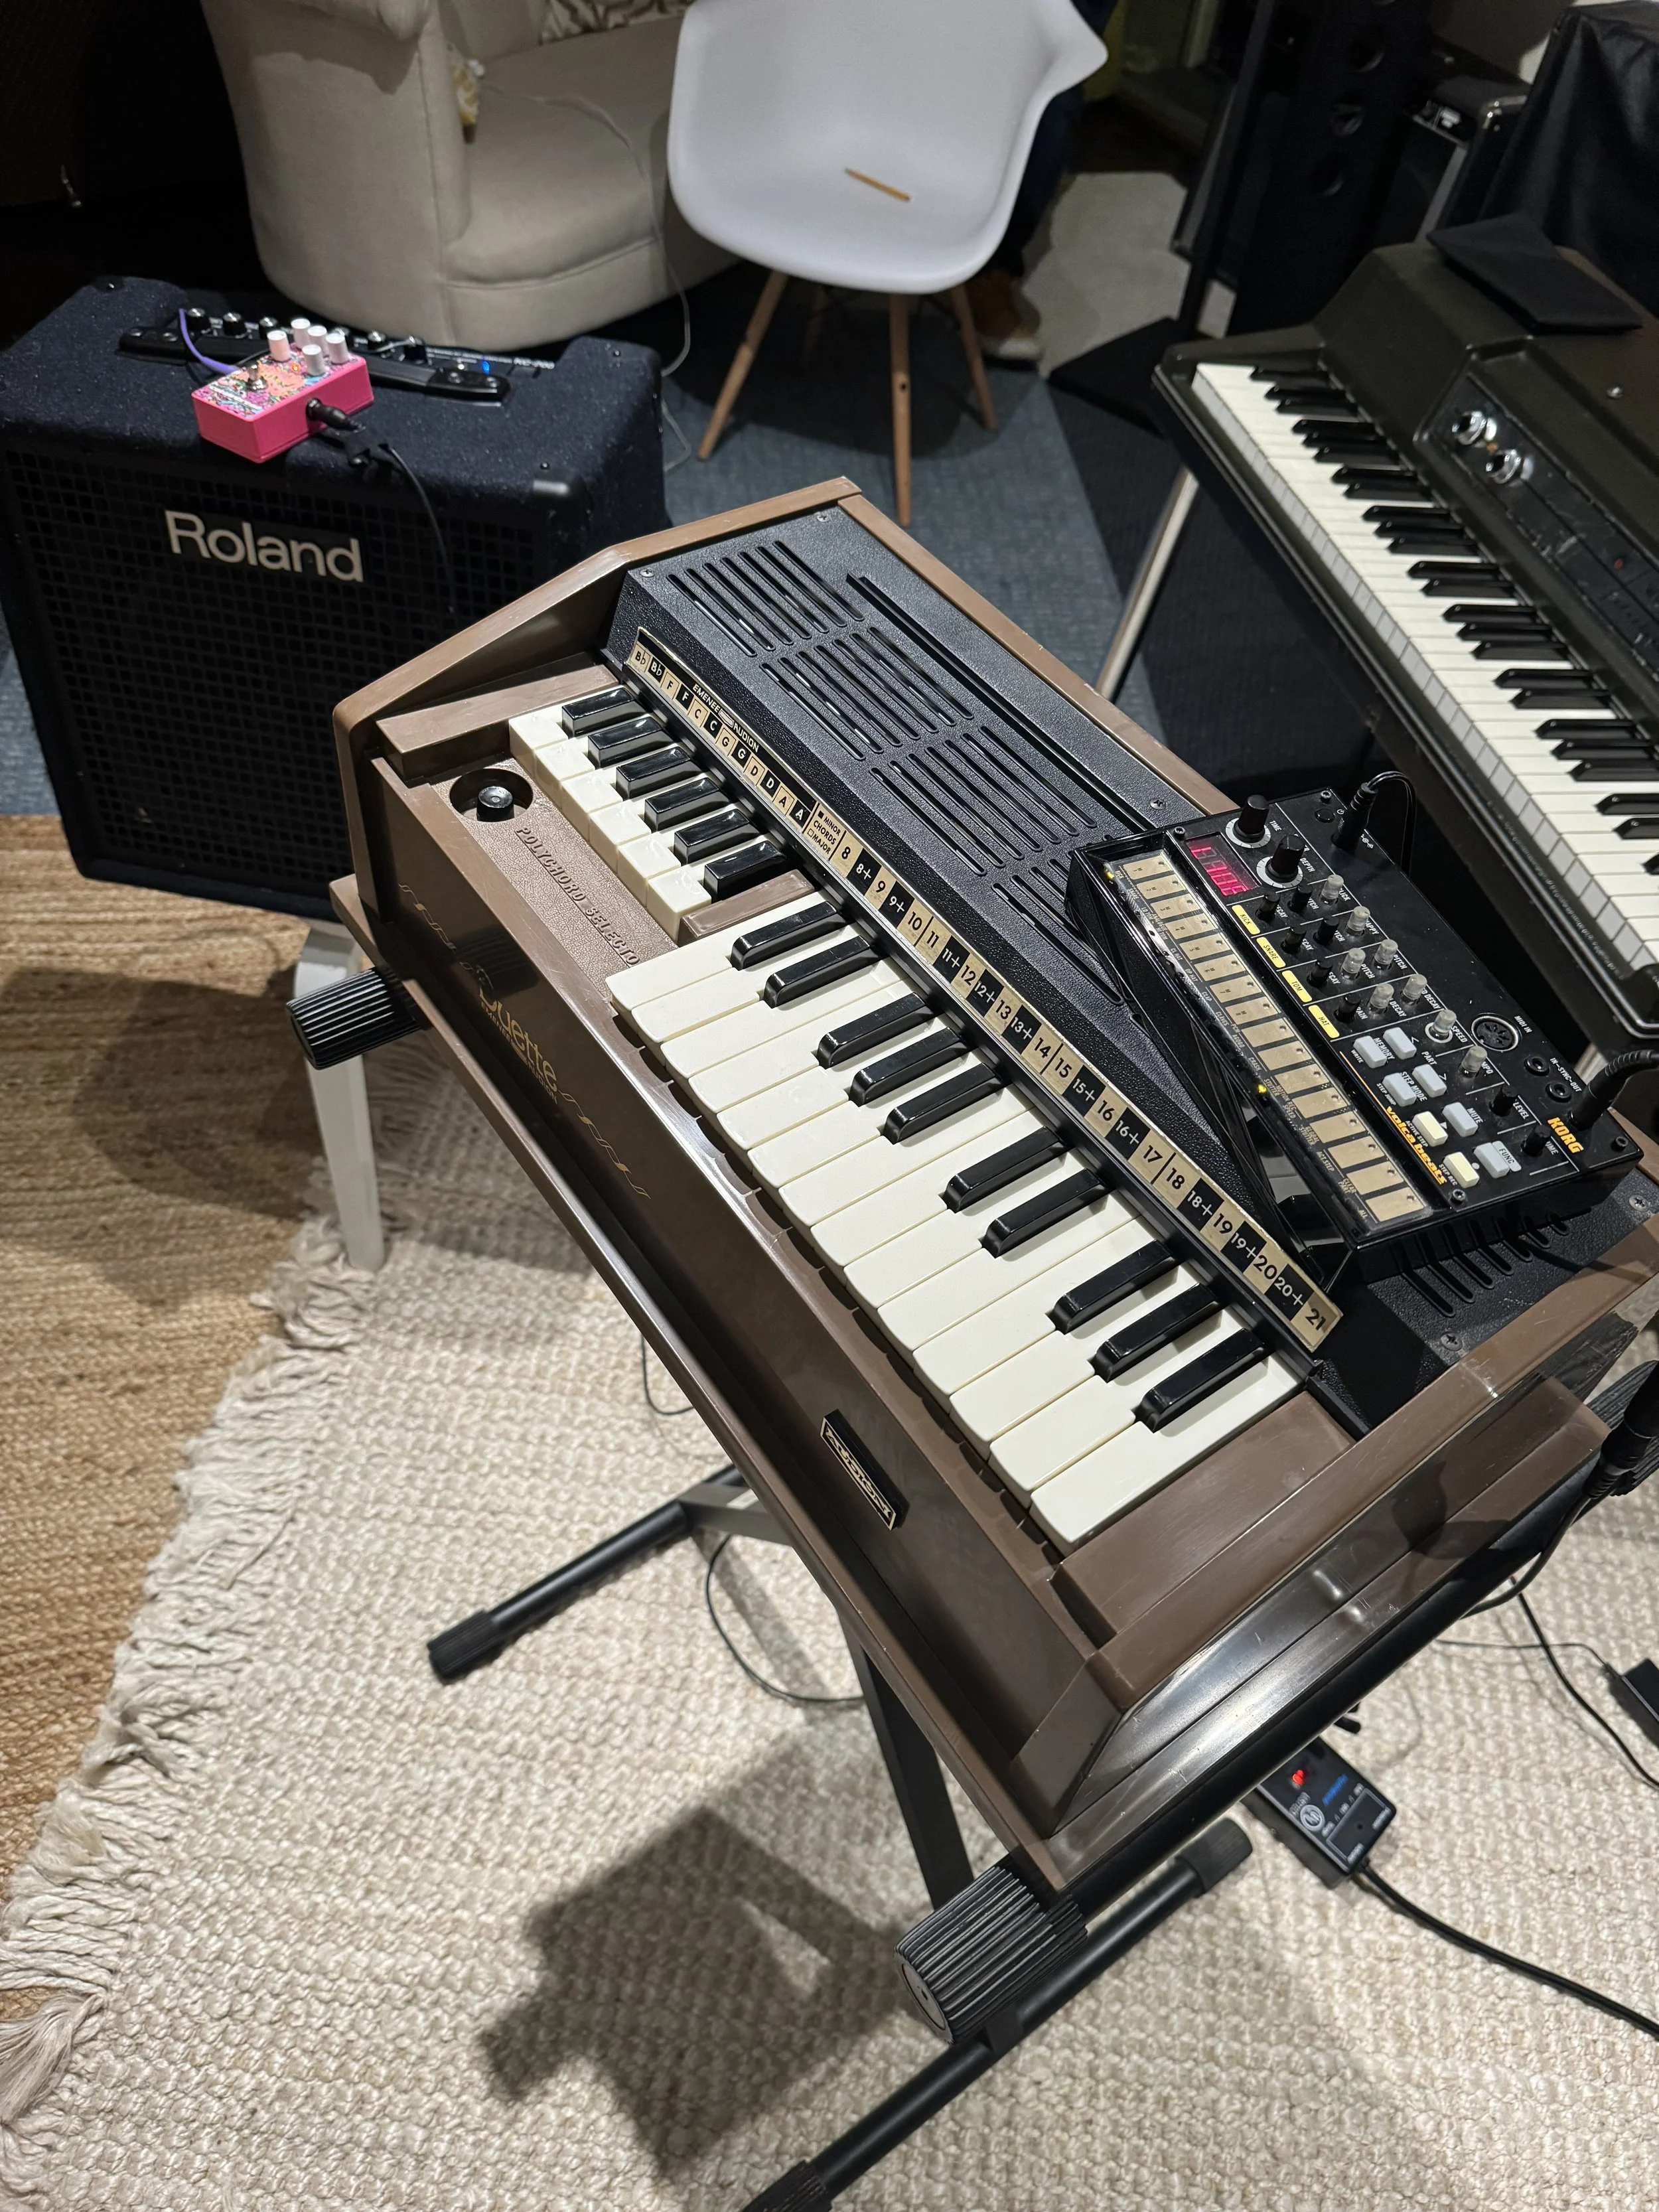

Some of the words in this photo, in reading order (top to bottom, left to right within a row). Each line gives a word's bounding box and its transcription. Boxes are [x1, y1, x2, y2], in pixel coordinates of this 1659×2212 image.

[165, 510, 364, 583] Roland
[692, 684, 720, 713] EMENEE
[733, 722, 759, 753] AUDION
[682, 692, 689, 701] F
[694, 708, 701, 719] C
[710, 721, 717, 731] C
[721, 737, 729, 747] G
[737, 748, 746, 759] G
[751, 765, 759, 776] D
[766, 777, 774, 788] D
[779, 796, 787, 808] A
[795, 809, 803, 820] A
[813, 820, 837, 845] CHORDS
[823, 816, 841, 836] MINOR
[1269, 820, 1281, 832] TIME
[812, 834, 831, 855] MAJOR
[1299, 857, 1315, 872] DEPTH
[516, 828, 587, 901] POLYCHORD
[585, 908, 640, 965] SELECTO
[1339, 887, 1351, 901] LICK
[1240, 914, 1252, 925] KICK
[1263, 944, 1278, 960] SNARE
[1394, 954, 1407, 970] PITCH
[1361, 964, 1376, 979] PITCH
[1291, 981, 1303, 992] TOM
[1202, 992, 1212, 1002] CLAP
[1424, 994, 1441, 1009] DECAY
[1390, 1000, 1407, 1017] DECAY
[1216, 1011, 1230, 1027] CLAVES
[1319, 1017, 1329, 1027] HAT
[1514, 1015, 1527, 1029] MIDI
[1232, 1035, 1245, 1048] AGOGO
[1451, 1025, 1468, 1043] SPEED
[1351, 1049, 1364, 1064] WRITE
[1374, 1037, 1395, 1060] MEMORY
[1421, 1051, 1437, 1065] PART
[841, 846, 851, 859] 8
[855, 863, 871, 879] 8+
[875, 881, 886, 893] 9
[889, 896, 905, 913] 9+
[907, 912, 922, 930] 10
[926, 930, 939, 948] 11
[942, 948, 961, 968] 11+
[960, 964, 976, 985] 12
[974, 981, 995, 1003] 12+
[995, 1000, 1012, 1019] 13
[1010, 1016, 1033, 1040] 13+
[1034, 1037, 1051, 1059] 14
[1054, 1057, 1072, 1078] 15
[1071, 1078, 1096, 1101] 15+
[1096, 1100, 1115, 1122] 16
[1115, 1120, 1139, 1145] 16+
[1143, 1145, 1163, 1163] 17
[1166, 1167, 1185, 1190] 18
[1187, 1190, 1213, 1217] 18+
[1213, 1213, 1233, 1234] 19
[1231, 1232, 1256, 1259] 19+
[1253, 1254, 1277, 1280] 20
[1273, 1276, 1303, 1306] 20+
[1305, 1307, 1326, 1331] 21
[1263, 1078, 1279, 1095] STUTTER
[1376, 1082, 1387, 1095] STEP
[1384, 1092, 1396, 1106] JUMP
[1400, 1071, 1415, 1086] STEP
[1410, 1084, 1427, 1102] MODE
[1276, 1084, 1291, 1102] MOTION
[1287, 1098, 1297, 1110] REC
[1467, 1108, 1483, 1124] MUTE
[1512, 1102, 1529, 1120] LEVEL
[1299, 1127, 1315, 1145] STUTTER
[1305, 1126, 1320, 1142] GLOBAL
[1406, 1120, 1420, 1137] ACTIVE
[1417, 1134, 1428, 1147] STEP
[1547, 1117, 1584, 1153] KORG
[1386, 1106, 1416, 1143] volca
[1414, 1143, 1447, 1185] beats
[1498, 1148, 1515, 1164] FUNC
[1439, 1163, 1449, 1176] STEP
[1447, 1174, 1457, 1186] REC
[1338, 1181, 1351, 1195] PART
[1342, 1177, 1356, 1193] CLEAR
